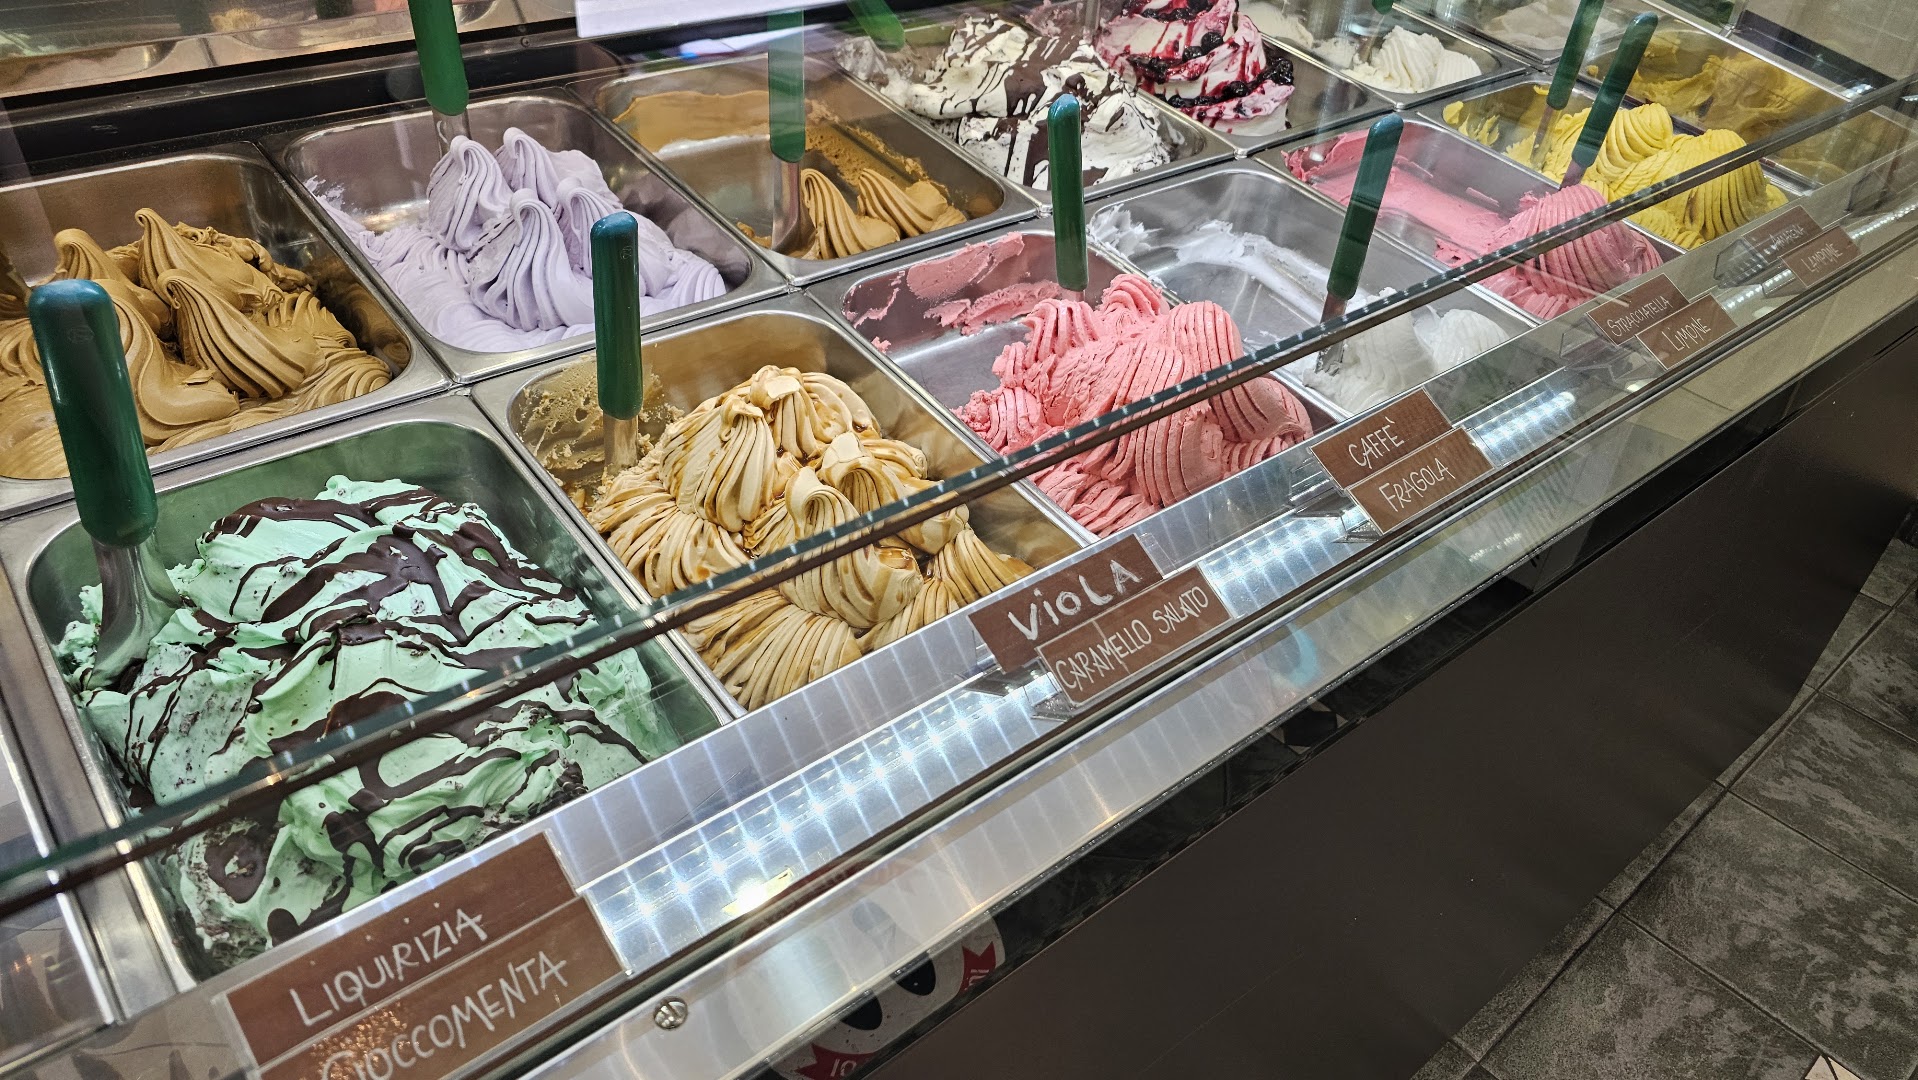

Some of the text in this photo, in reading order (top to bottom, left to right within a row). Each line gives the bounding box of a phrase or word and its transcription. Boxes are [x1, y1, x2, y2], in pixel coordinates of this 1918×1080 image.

[1801, 243, 1843, 272] LAMPONE
[1607, 295, 1674, 337] STRACCIATELLA
[1662, 317, 1711, 351] LIMONE
[1348, 416, 1405, 470] CAFFÈ
[1379, 458, 1456, 512] FRAGOLA
[1055, 586, 1209, 692] CARAMELLO SALATO
[289, 907, 488, 1027] LIQUIRIZIA
